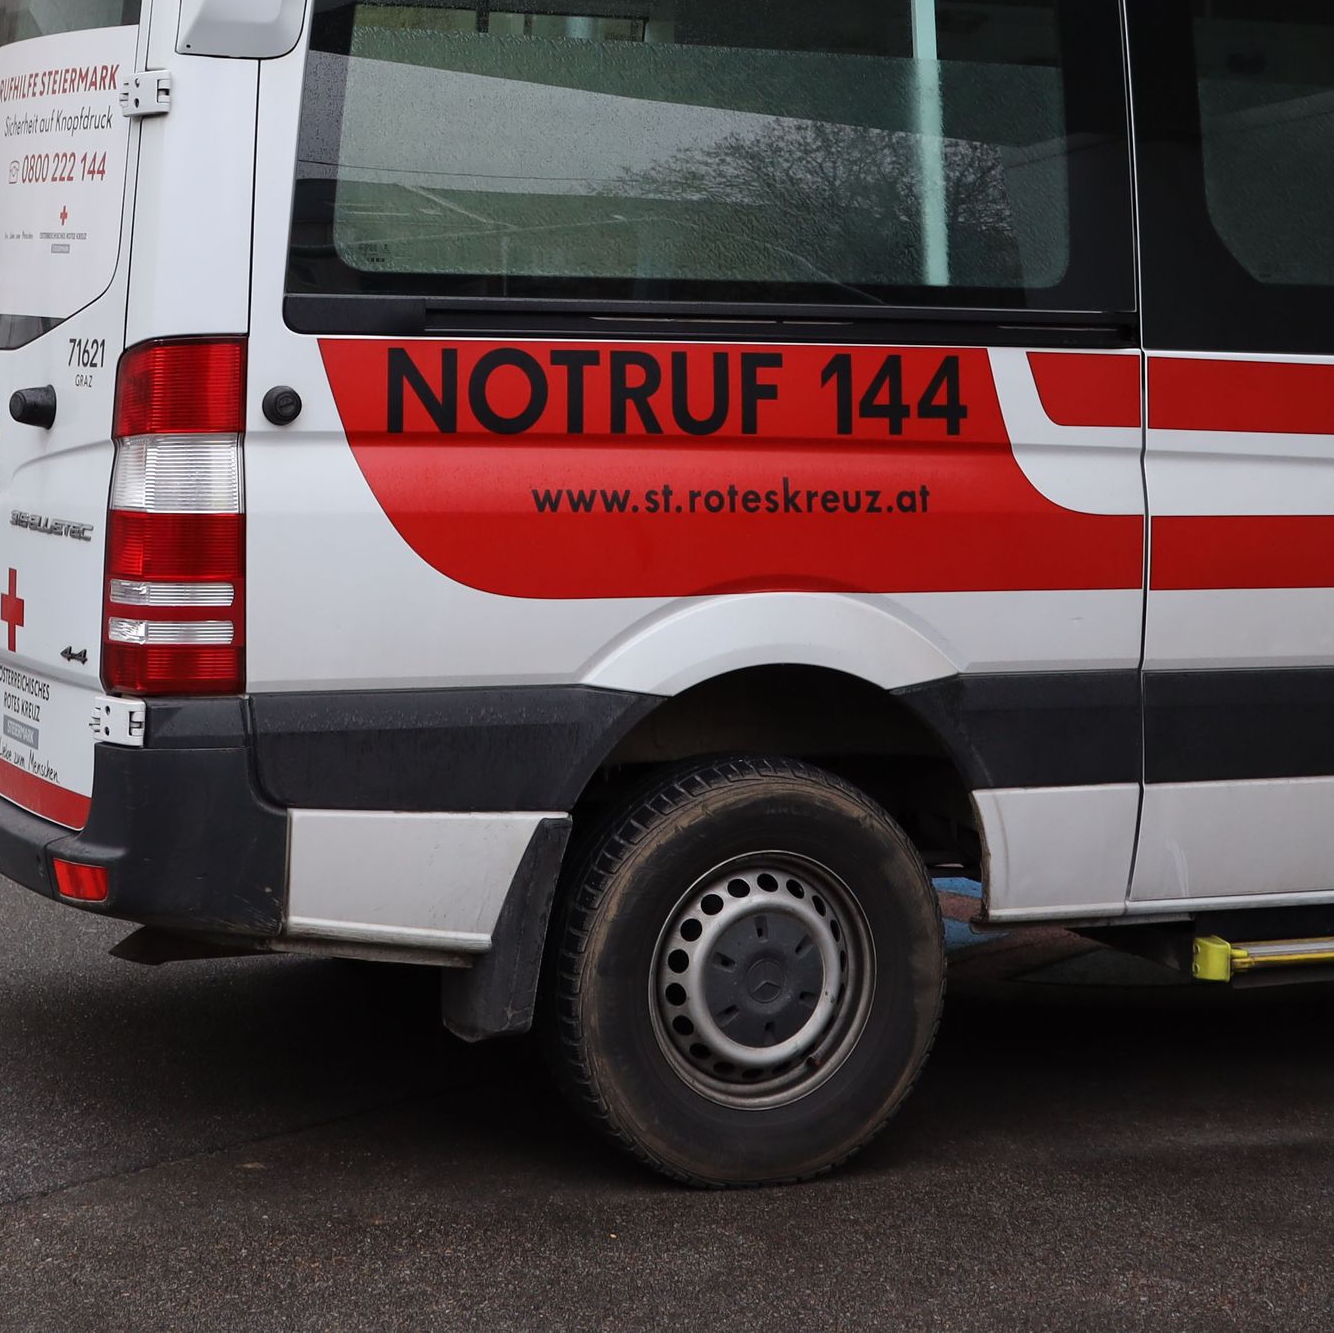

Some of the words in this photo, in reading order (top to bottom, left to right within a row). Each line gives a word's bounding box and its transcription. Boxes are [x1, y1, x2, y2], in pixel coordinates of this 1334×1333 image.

[39, 64, 120, 97] STEIERMARK
[4, 111, 39, 138] Sicherheit
[39, 109, 55, 133] auf
[55, 106, 113, 137] Knopfdruck
[21, 153, 50, 184] 0800
[51, 152, 77, 183] 222
[80, 151, 108, 182] 144
[68, 338, 106, 368] 71621
[75, 374, 93, 388] GRAZ
[385, 347, 783, 436] NOTRUF
[820, 353, 968, 437] 144
[531, 477, 930, 514] www.st.roteskreuz.at
[4, 691, 20, 713] ROTES
[21, 699, 41, 722] KREUZ
